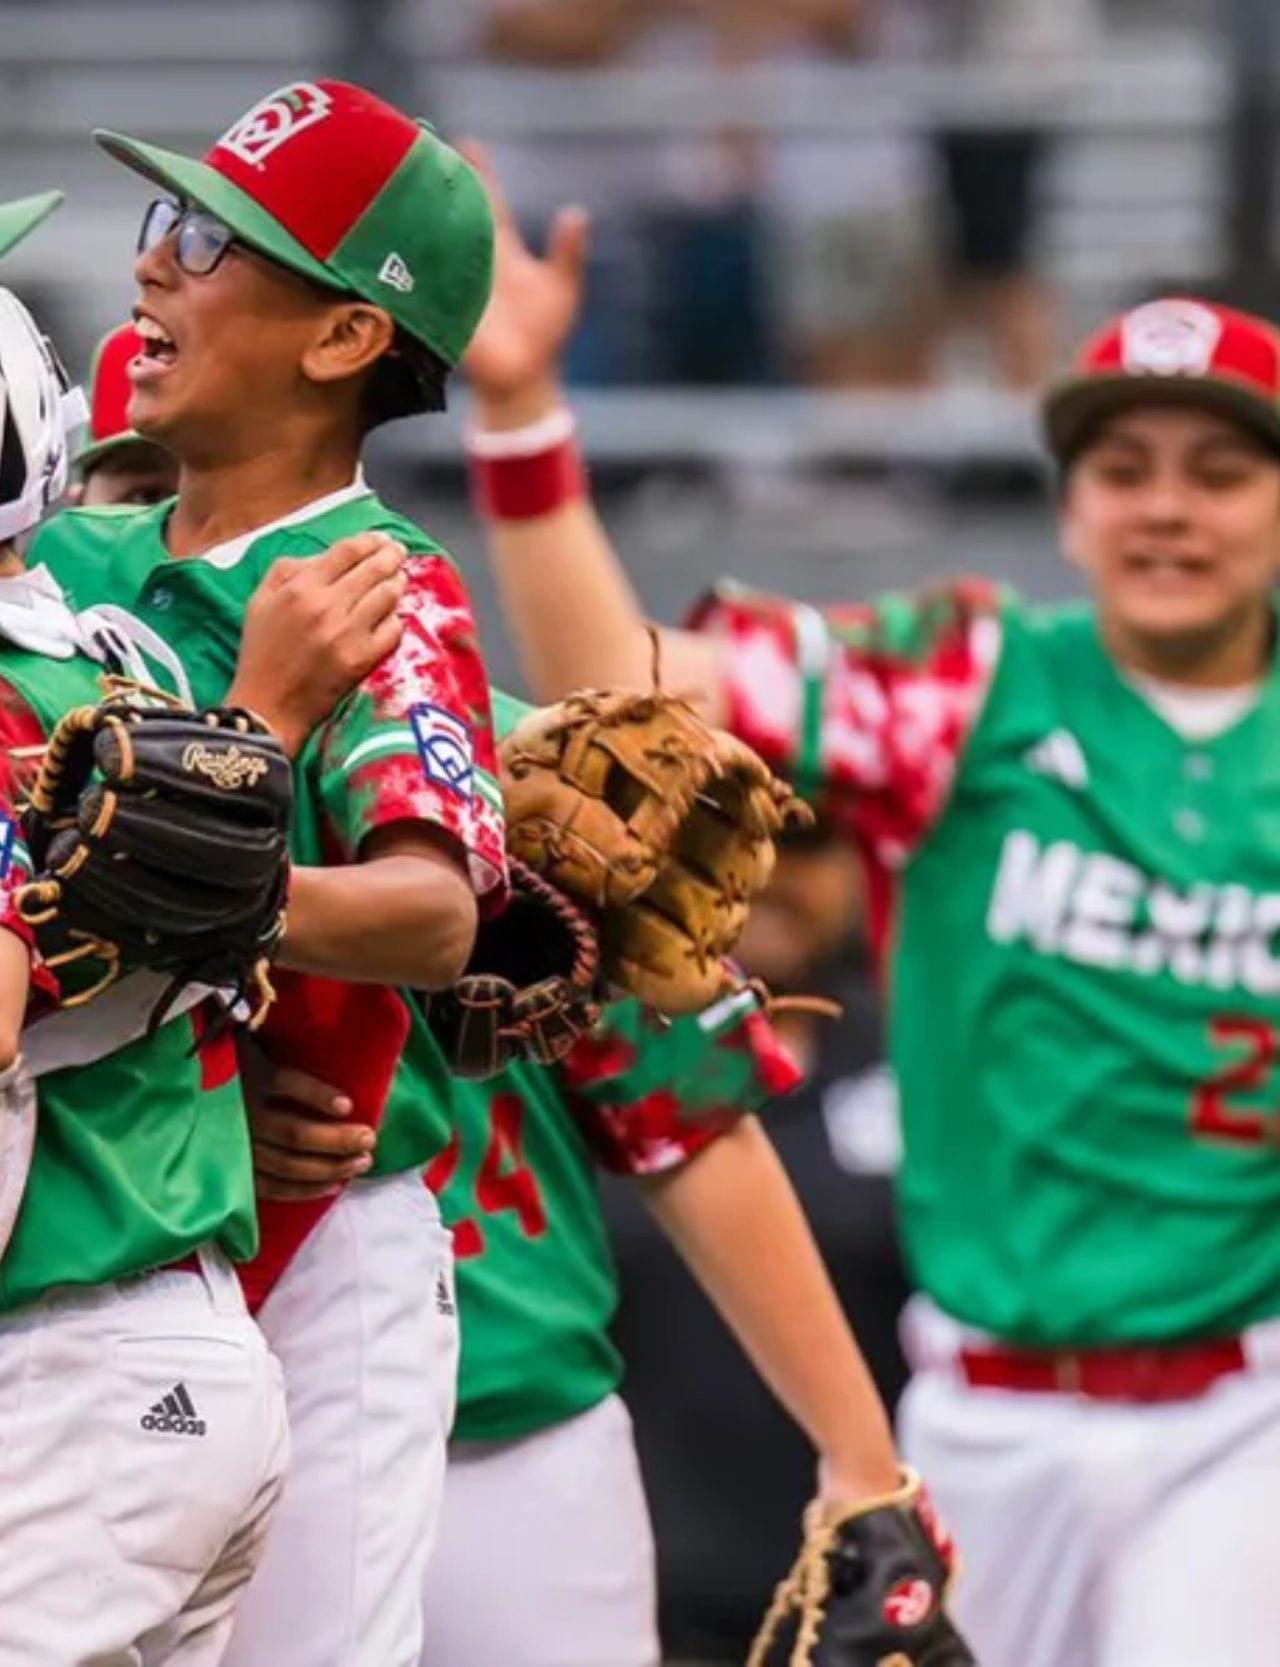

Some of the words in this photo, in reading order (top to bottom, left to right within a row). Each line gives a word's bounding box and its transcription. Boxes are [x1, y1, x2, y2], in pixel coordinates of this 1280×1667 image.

[182, 742, 269, 789] Rawlings
[1186, 1012, 1280, 1150] 2
[140, 1411, 206, 1437] adidas
